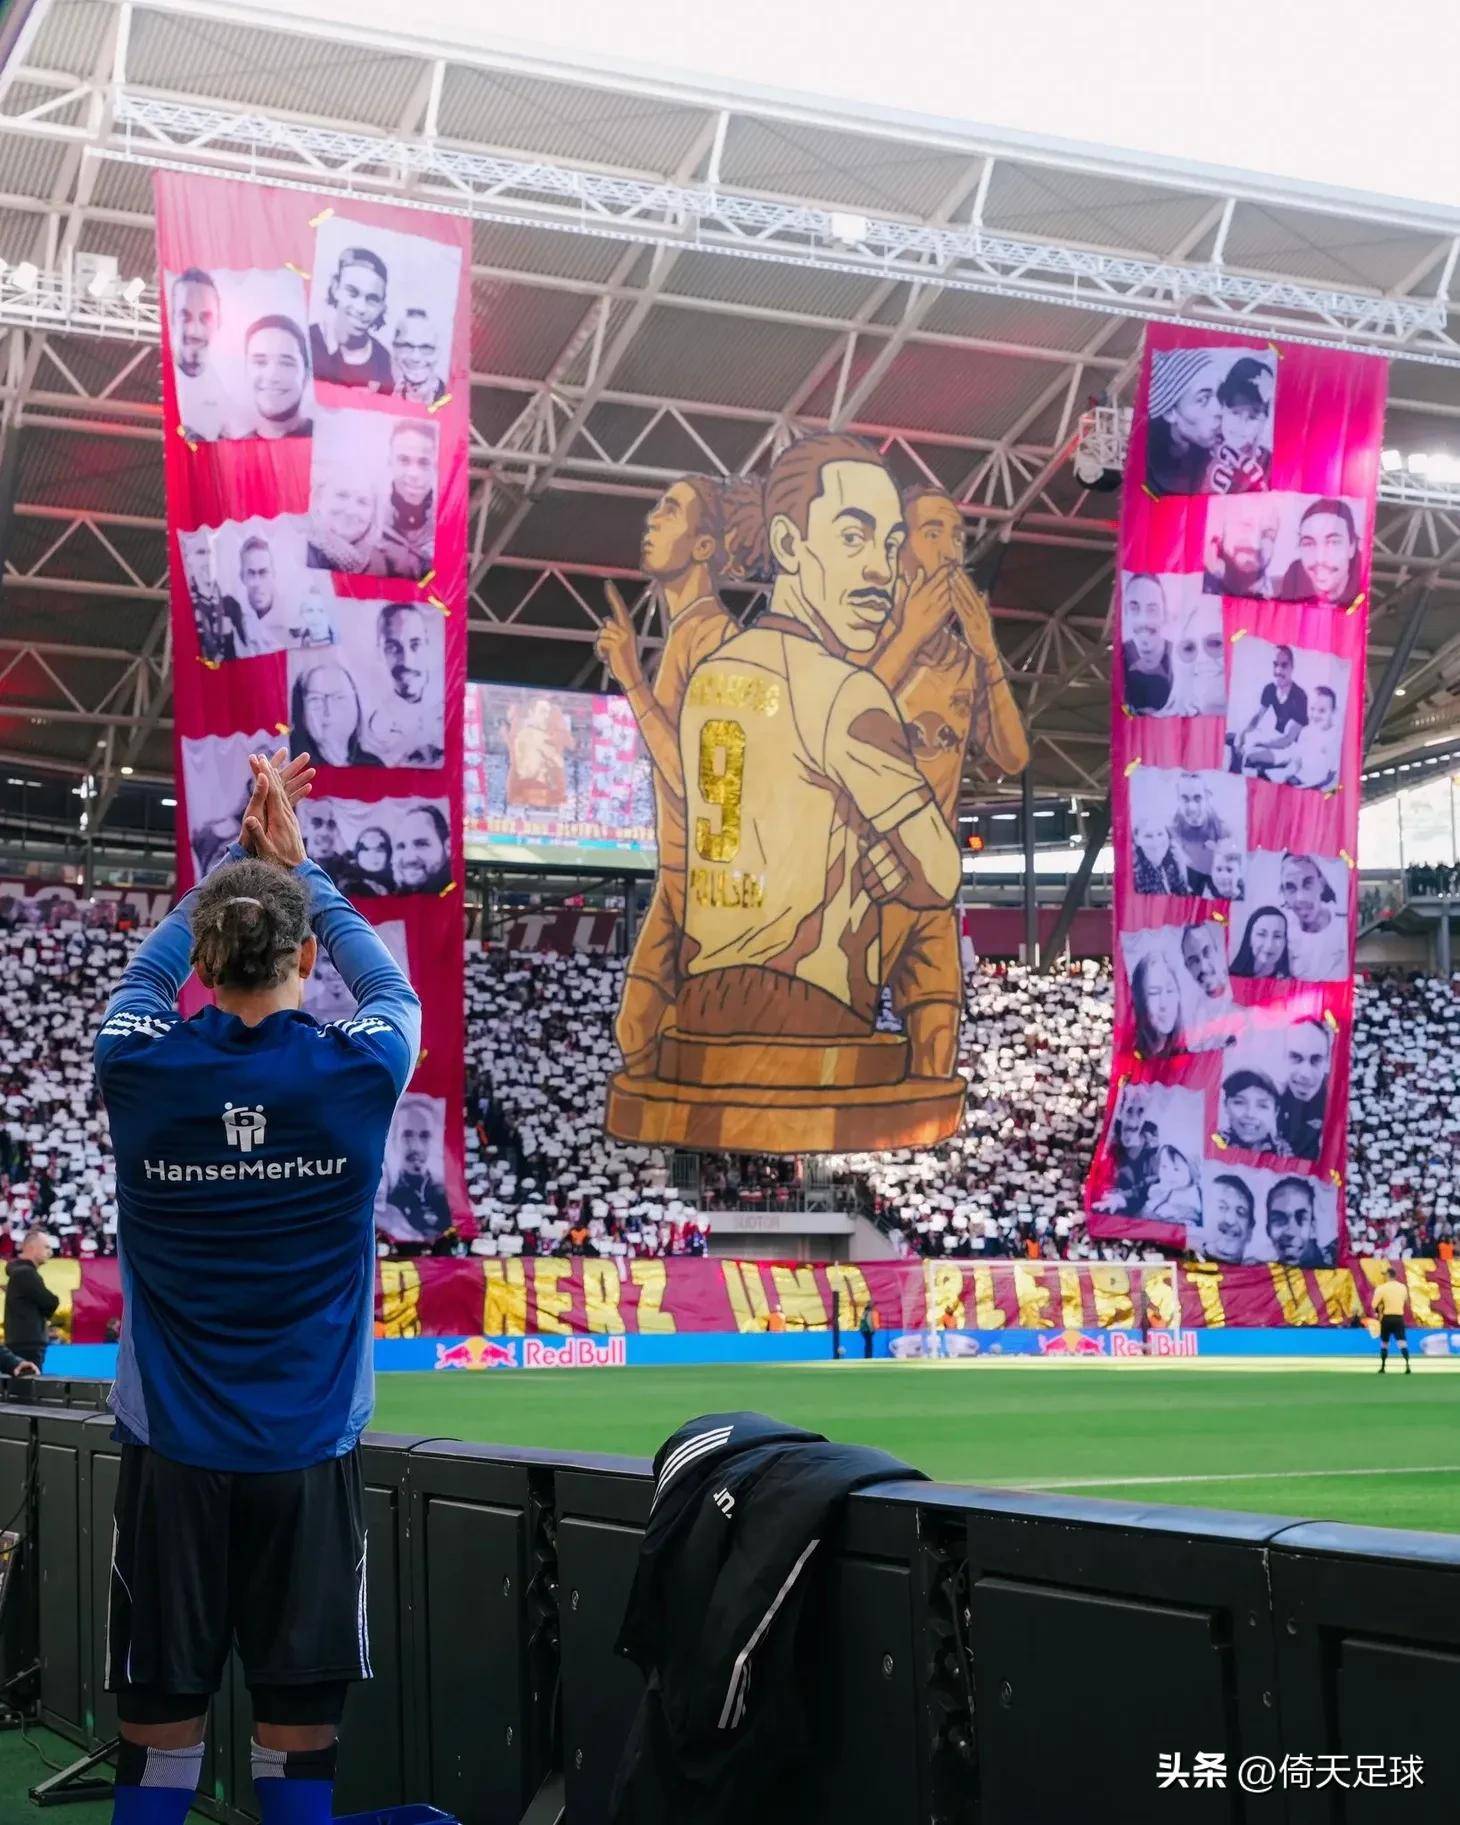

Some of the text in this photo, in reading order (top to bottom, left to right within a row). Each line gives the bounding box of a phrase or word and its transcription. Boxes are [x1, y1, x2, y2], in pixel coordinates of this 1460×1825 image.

[695, 719, 746, 863] 9
[143, 1156, 348, 1182] HanseMerkur
[482, 1257, 677, 1336] HERZ
[526, 1338, 624, 1365] Red Bull
